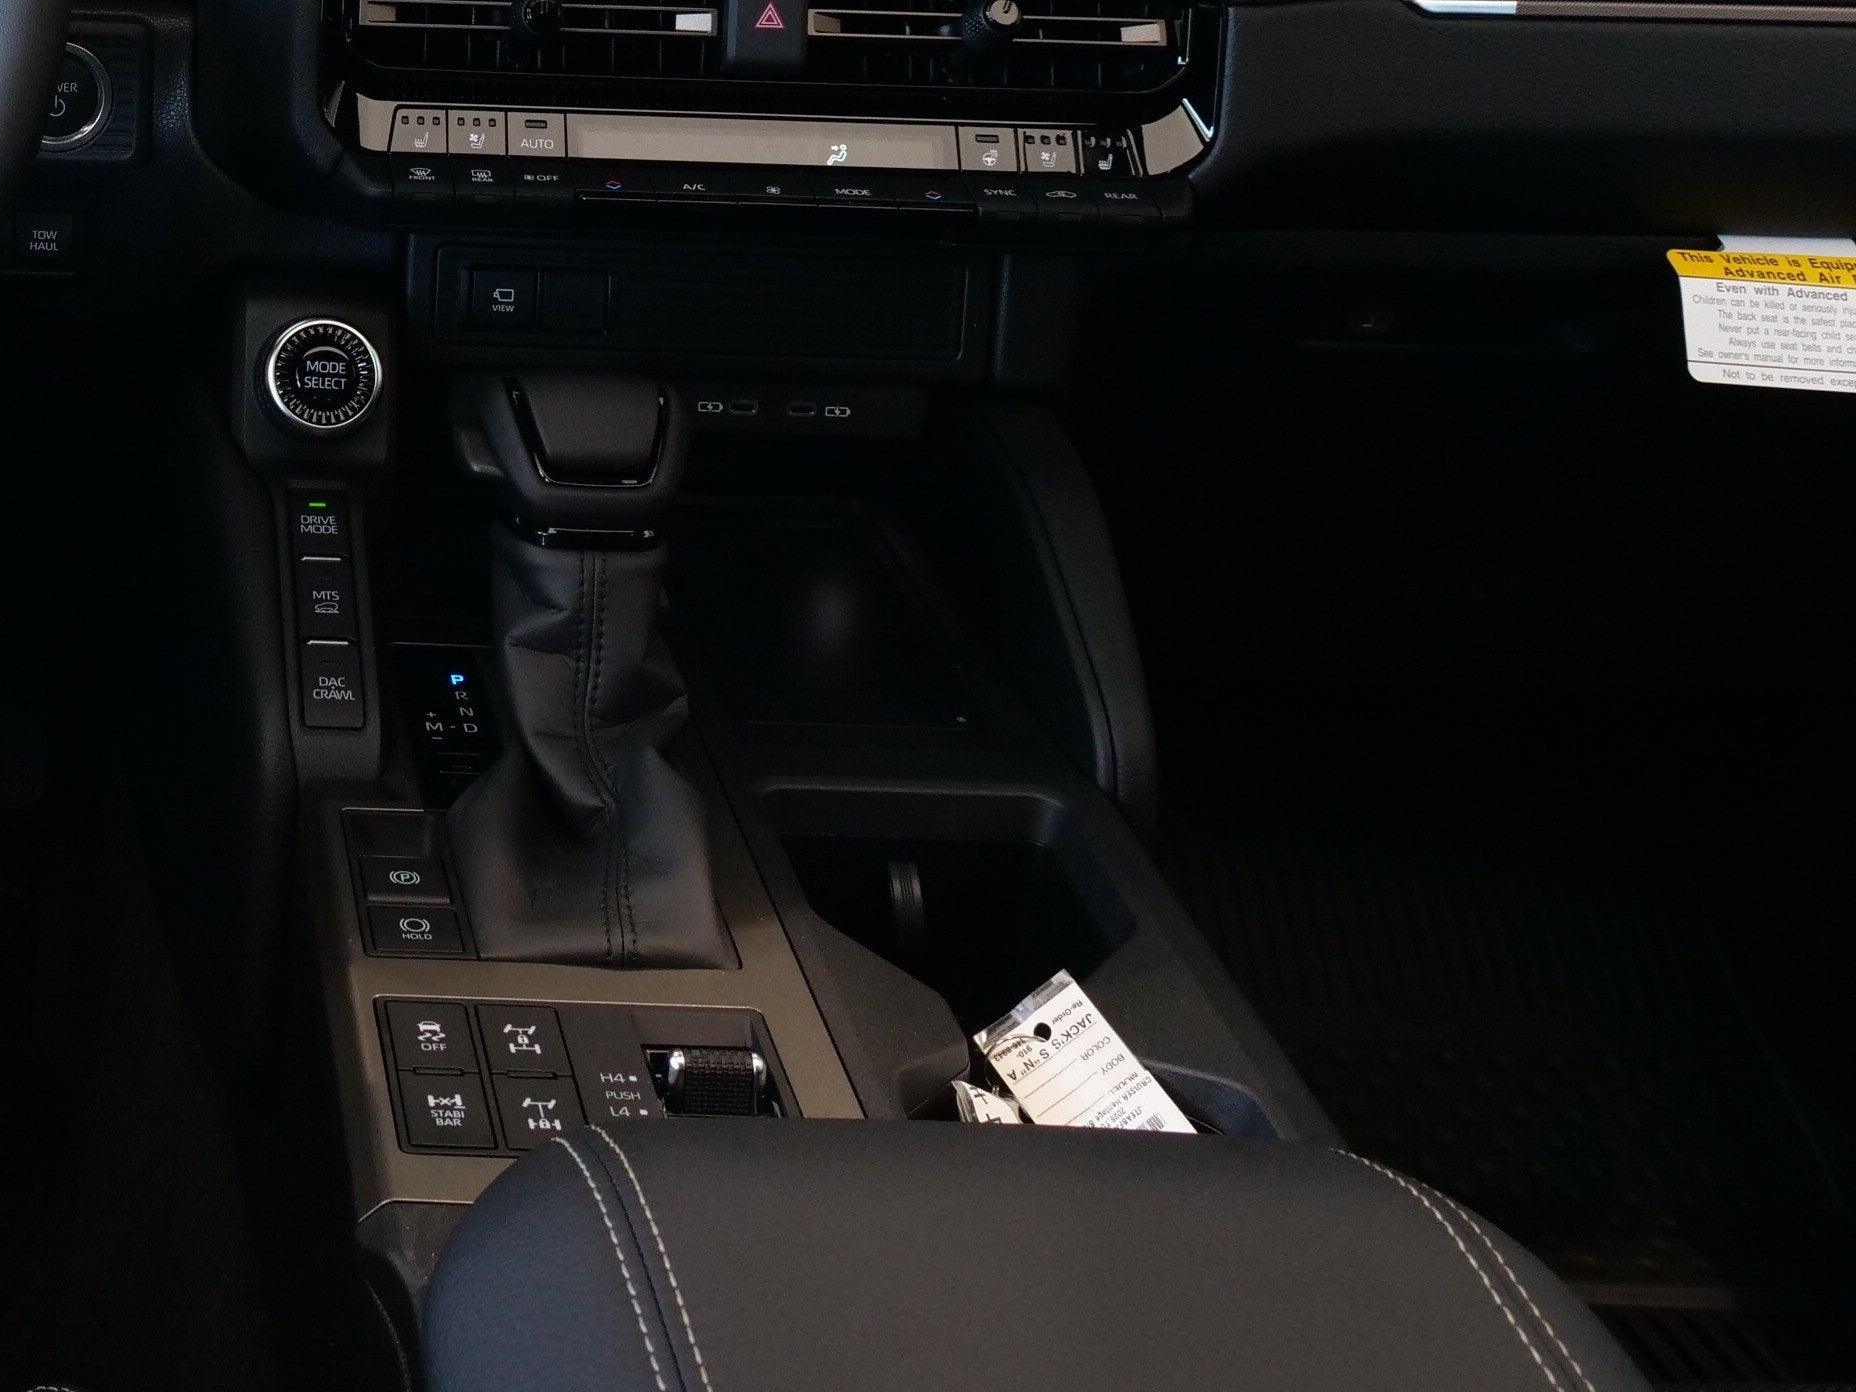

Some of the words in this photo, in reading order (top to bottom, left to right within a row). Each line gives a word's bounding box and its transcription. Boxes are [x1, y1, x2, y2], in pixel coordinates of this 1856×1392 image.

[520, 138, 554, 150] AUTO
[536, 174, 560, 182] OFF
[683, 183, 706, 191] A/C
[834, 187, 873, 196] MODE
[983, 188, 1017, 198] SYNC
[1103, 191, 1138, 201] REAR
[32, 230, 58, 240] TOW
[29, 242, 58, 251] HAUL
[1678, 252, 1714, 263] This
[1722, 254, 1778, 267] Vehicle
[1787, 257, 1801, 267] is
[1724, 267, 1806, 282] Advanced
[1819, 273, 1841, 284] Air
[1717, 282, 1746, 294] Even
[1754, 286, 1779, 296] with
[1787, 287, 1848, 301] Advanced
[1693, 295, 1726, 305] Children
[1750, 297, 1759, 308] be
[1764, 299, 1785, 310] killed
[1789, 303, 1797, 311] or
[1802, 302, 1837, 316] seriously
[1717, 309, 1733, 319] The
[1738, 310, 1757, 321] back
[1761, 313, 1778, 322] seat
[1783, 313, 1789, 323] is
[1794, 315, 1806, 324] the
[1811, 316, 1835, 326] safest
[1719, 323, 1742, 334] Never
[1747, 326, 1759, 336] put
[1774, 328, 1817, 340] rear-facing
[1821, 329, 1841, 340] child
[1728, 337, 1756, 349] Always
[1761, 341, 1776, 349] use
[1780, 341, 1797, 350] seat
[1802, 342, 1822, 352] belts
[1827, 344, 1842, 353] and
[1698, 348, 1713, 358] See
[1718, 350, 1749, 360] owner's
[1754, 353, 1783, 362] manual
[1788, 354, 1798, 364] for
[1803, 357, 1824, 365] more
[306, 361, 346, 374] MODE
[304, 376, 346, 390] SELECT
[1723, 369, 1740, 379] Not
[1746, 371, 1755, 380] to
[1762, 372, 1774, 381] be
[1780, 374, 1824, 385] removed
[300, 515, 336, 525] DRIVE
[300, 525, 338, 534] MODE
[312, 591, 339, 600] MTS
[319, 677, 345, 687] DAC
[450, 674, 465, 685] P
[313, 689, 355, 700] CRAWL
[455, 691, 469, 700] R
[459, 707, 474, 716] N
[425, 722, 444, 732] M
[464, 723, 478, 733] D
[1051, 999, 1084, 1026] Re-Order
[1051, 1012, 1094, 1050] JACK'S
[421, 1043, 446, 1051] OFF
[1081, 1036, 1111, 1061] COLOR
[1040, 1048, 1050, 1060] S
[1100, 1053, 1125, 1076] BODY
[599, 1073, 626, 1083] H4
[1007, 1070, 1018, 1082] A
[606, 1091, 641, 1100] PUSH
[431, 1110, 465, 1118] STABI
[609, 1106, 631, 1117] L4
